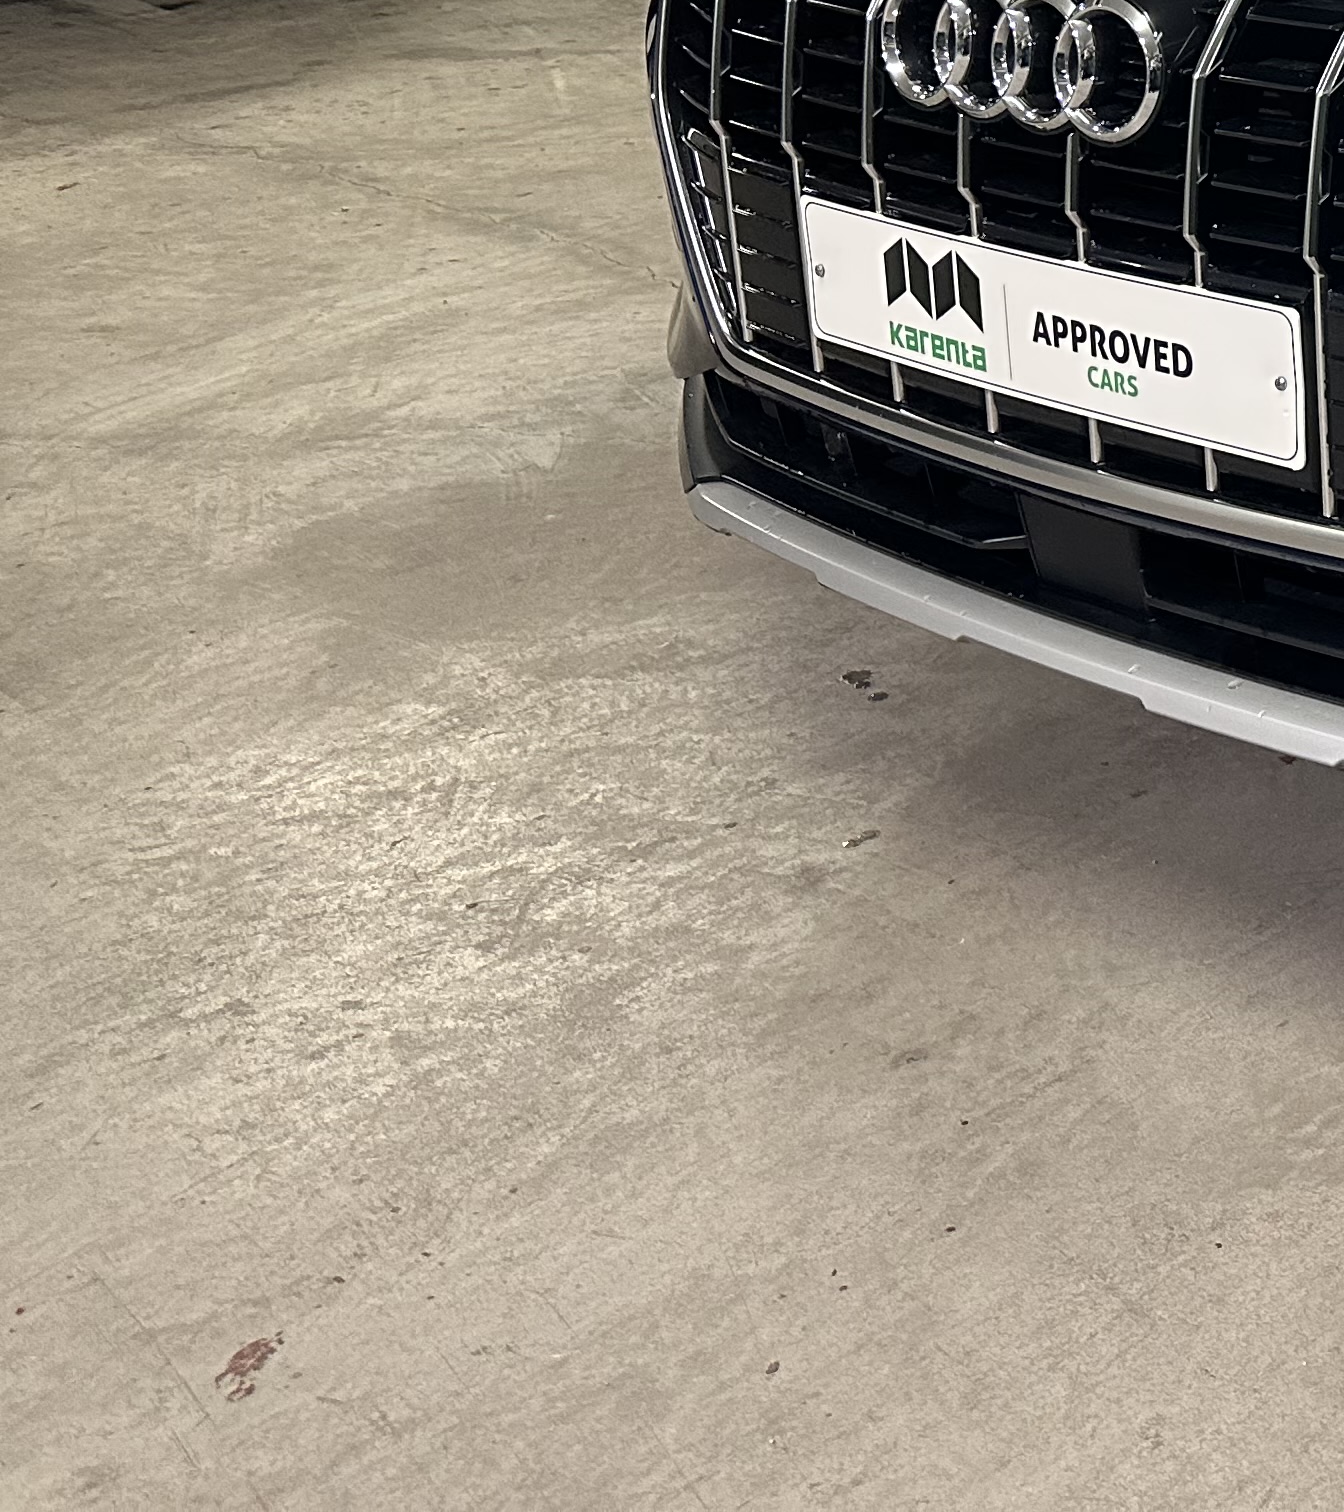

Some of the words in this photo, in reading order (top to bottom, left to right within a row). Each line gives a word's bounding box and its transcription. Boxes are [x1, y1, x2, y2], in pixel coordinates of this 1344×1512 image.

[889, 321, 987, 372] karenta
[1033, 311, 1193, 378] APPROVED
[1087, 366, 1139, 397] CARS
